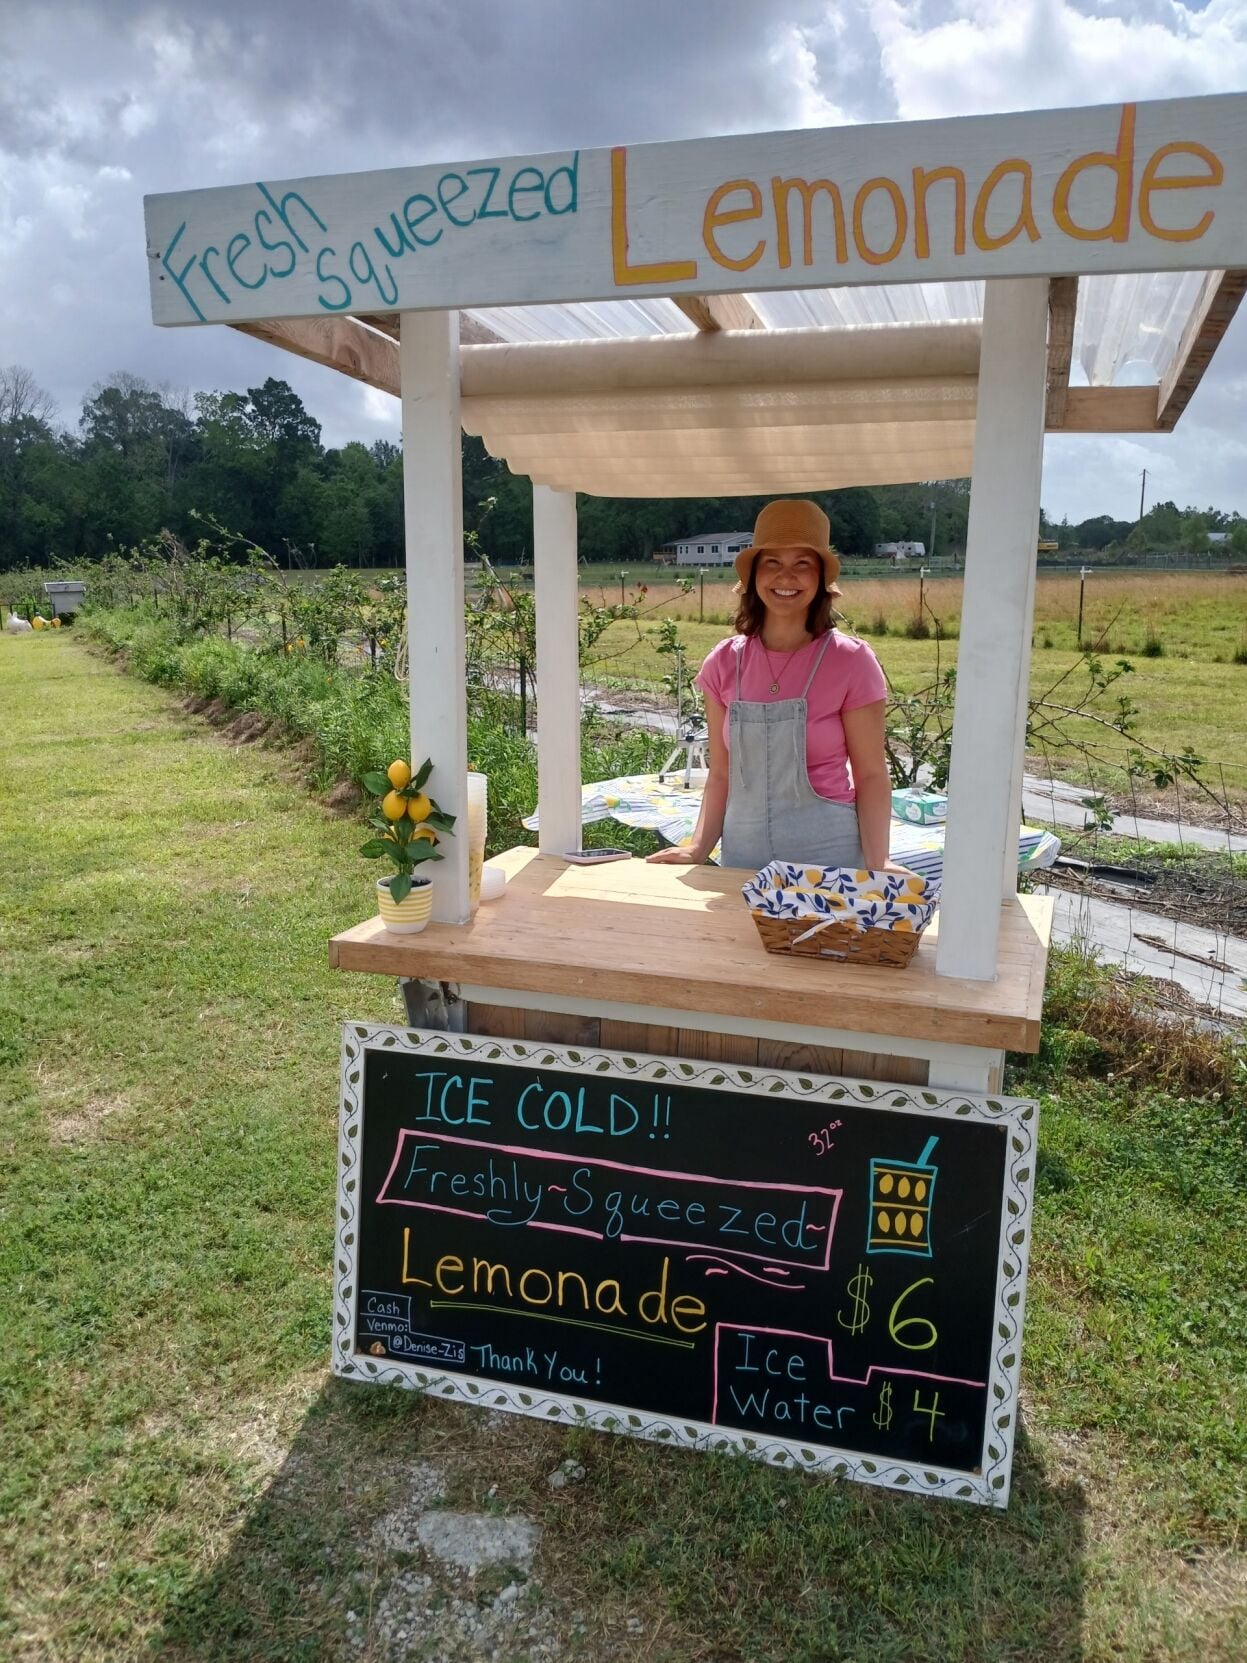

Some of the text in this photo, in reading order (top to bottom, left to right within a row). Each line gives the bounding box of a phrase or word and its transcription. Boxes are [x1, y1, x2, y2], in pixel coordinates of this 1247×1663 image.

[162, 181, 328, 322] Fresh
[611, 102, 1225, 287] Lemonade
[415, 1072, 671, 1140] ICE COLD!!
[402, 1228, 707, 1333] Lemonade
[366, 1318, 408, 1333] Venmo:
[367, 1296, 400, 1315] Cash
[735, 1333, 807, 1381] Ice
[730, 1385, 856, 1429] Water
